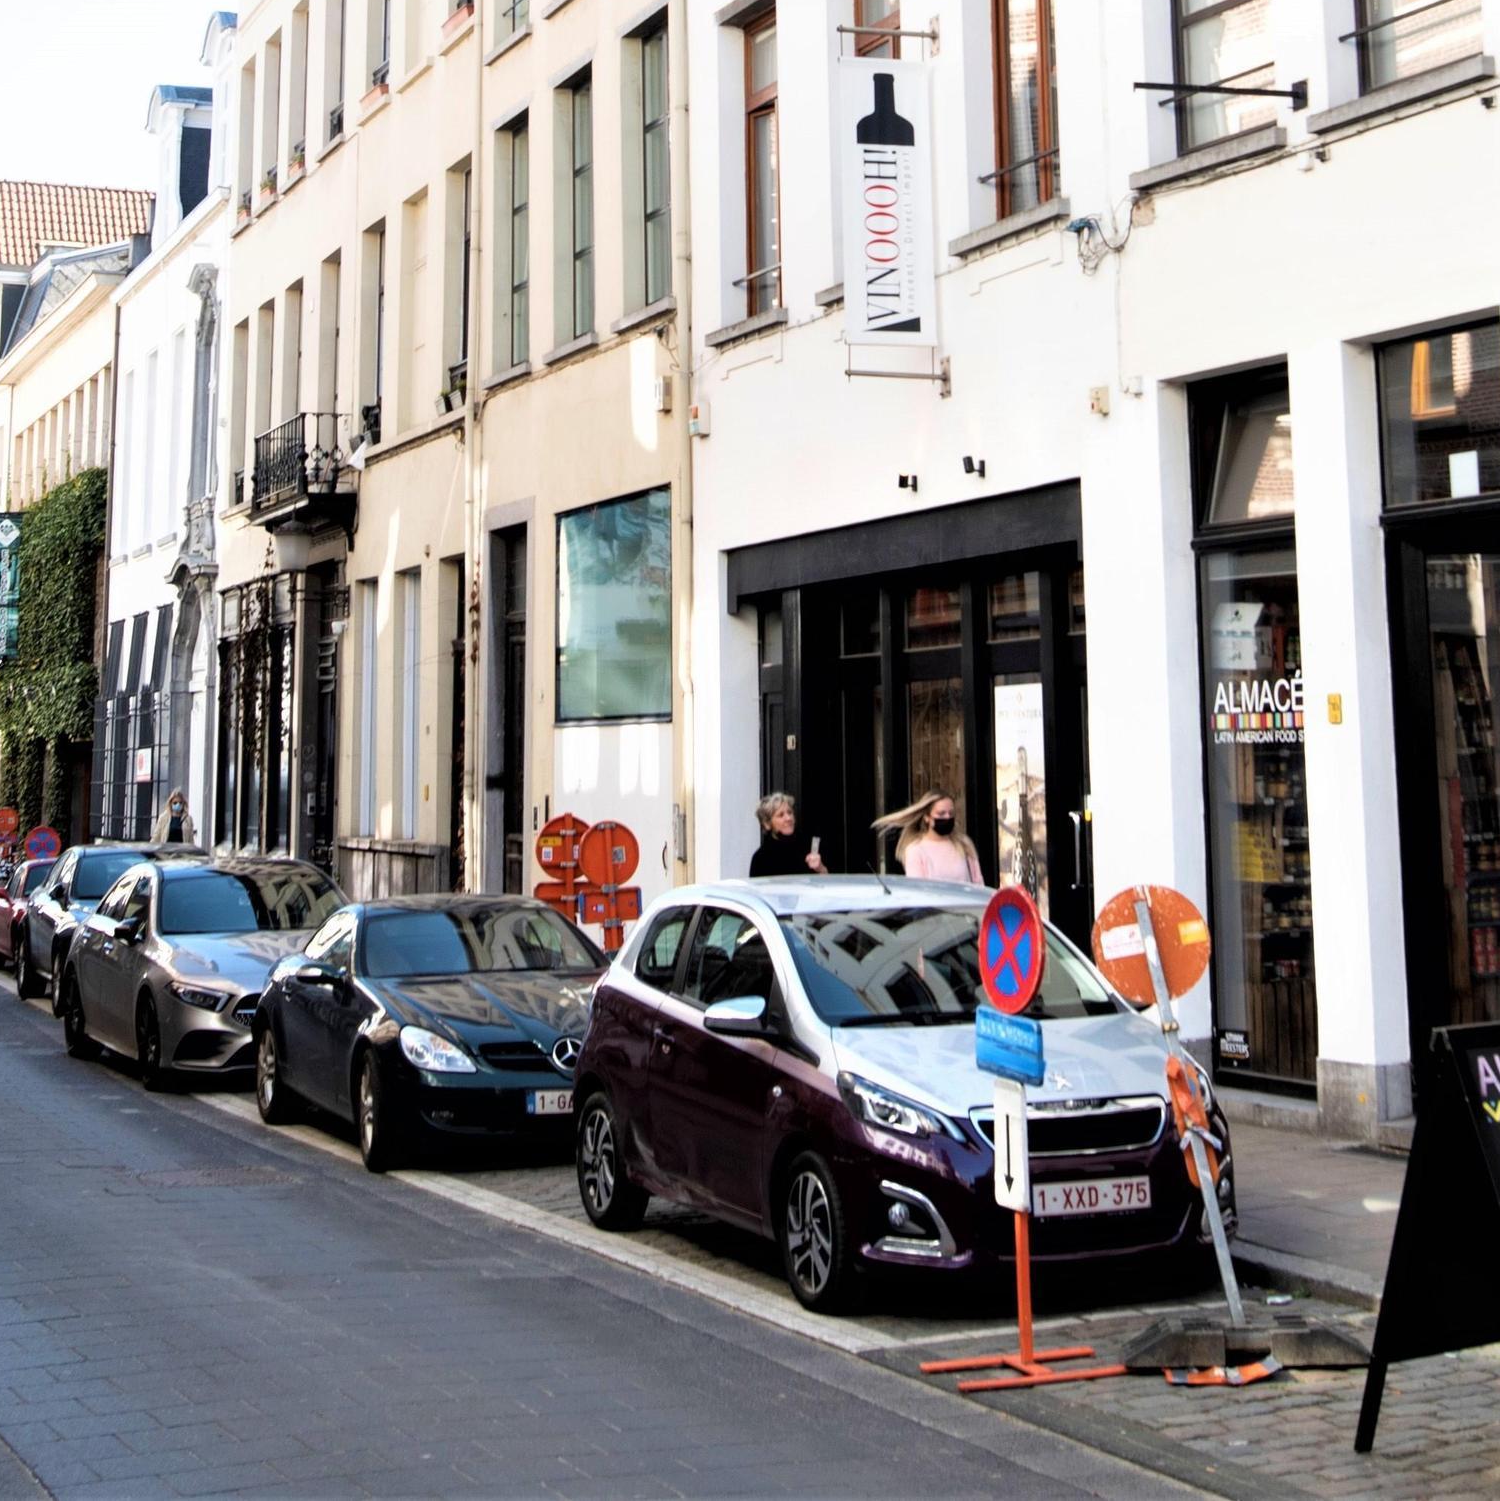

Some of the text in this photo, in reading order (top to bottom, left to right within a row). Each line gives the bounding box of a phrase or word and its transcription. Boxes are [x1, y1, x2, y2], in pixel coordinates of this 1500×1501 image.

[863, 149, 900, 324] VINOOOH!
[1214, 668, 1304, 713] ALMACÉ
[1214, 730, 1234, 744] LATIN
[1235, 729, 1274, 744] AMERICAN
[1275, 729, 1297, 742] FOOD
